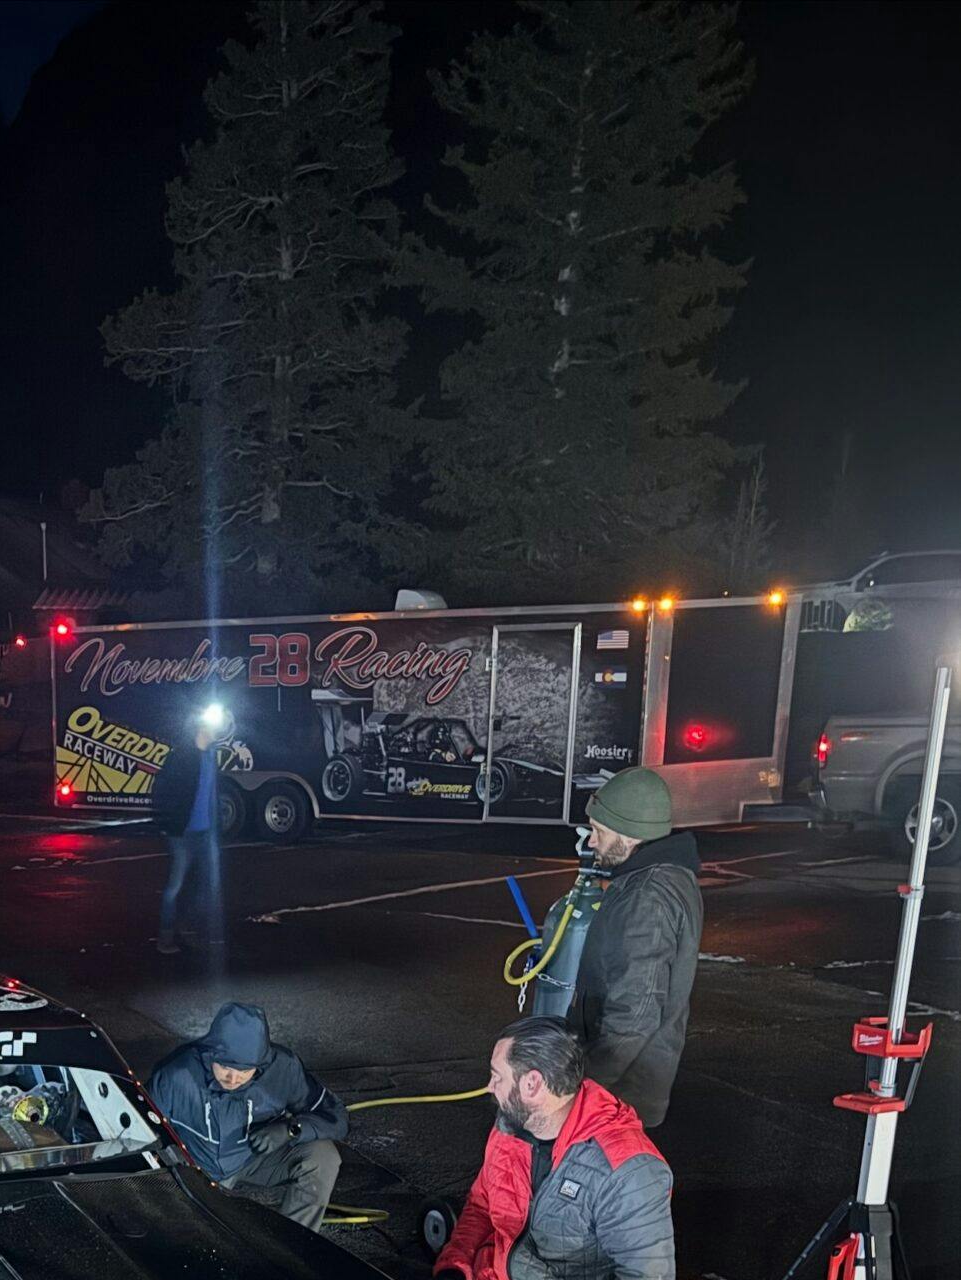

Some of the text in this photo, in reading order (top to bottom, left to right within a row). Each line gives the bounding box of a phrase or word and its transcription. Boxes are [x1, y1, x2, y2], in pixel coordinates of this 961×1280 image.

[65, 626, 473, 704] Novembre 28 Racing
[63, 733, 136, 775] RACEWAY
[68, 706, 172, 766] OVERDR
[584, 745, 628, 758] Hoosier
[388, 767, 406, 793] 28
